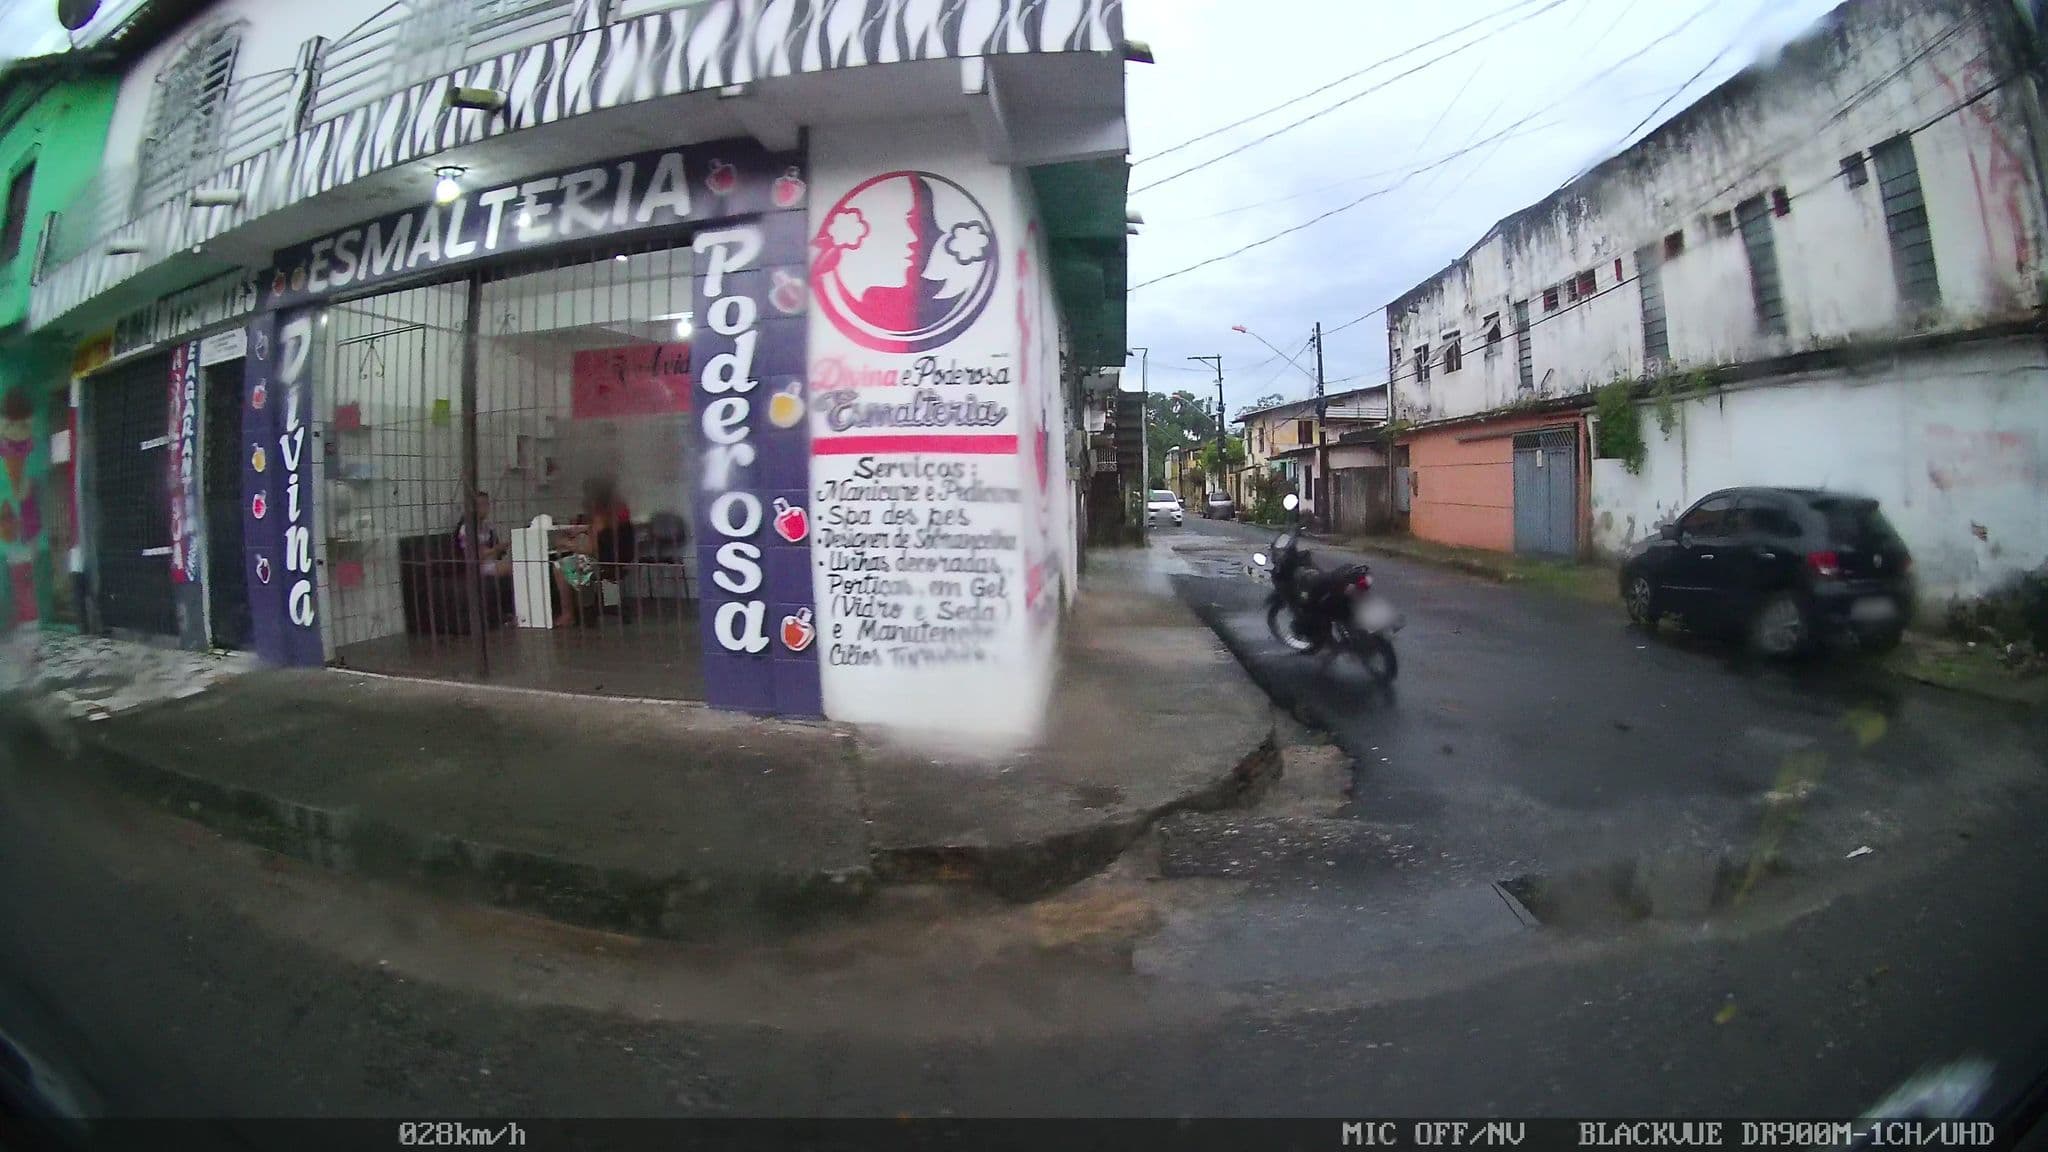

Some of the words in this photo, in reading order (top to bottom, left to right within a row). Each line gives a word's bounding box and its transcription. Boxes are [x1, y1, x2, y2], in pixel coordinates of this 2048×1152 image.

[308, 153, 691, 294] ESMALTERIA
[911, 355, 1011, 387] Poderosa
[693, 230, 769, 654] Poderosa
[280, 317, 315, 628] Divina
[828, 505, 871, 529] Spa
[882, 503, 919, 525] des
[970, 577, 1009, 598] Gel
[832, 623, 843, 640] e
